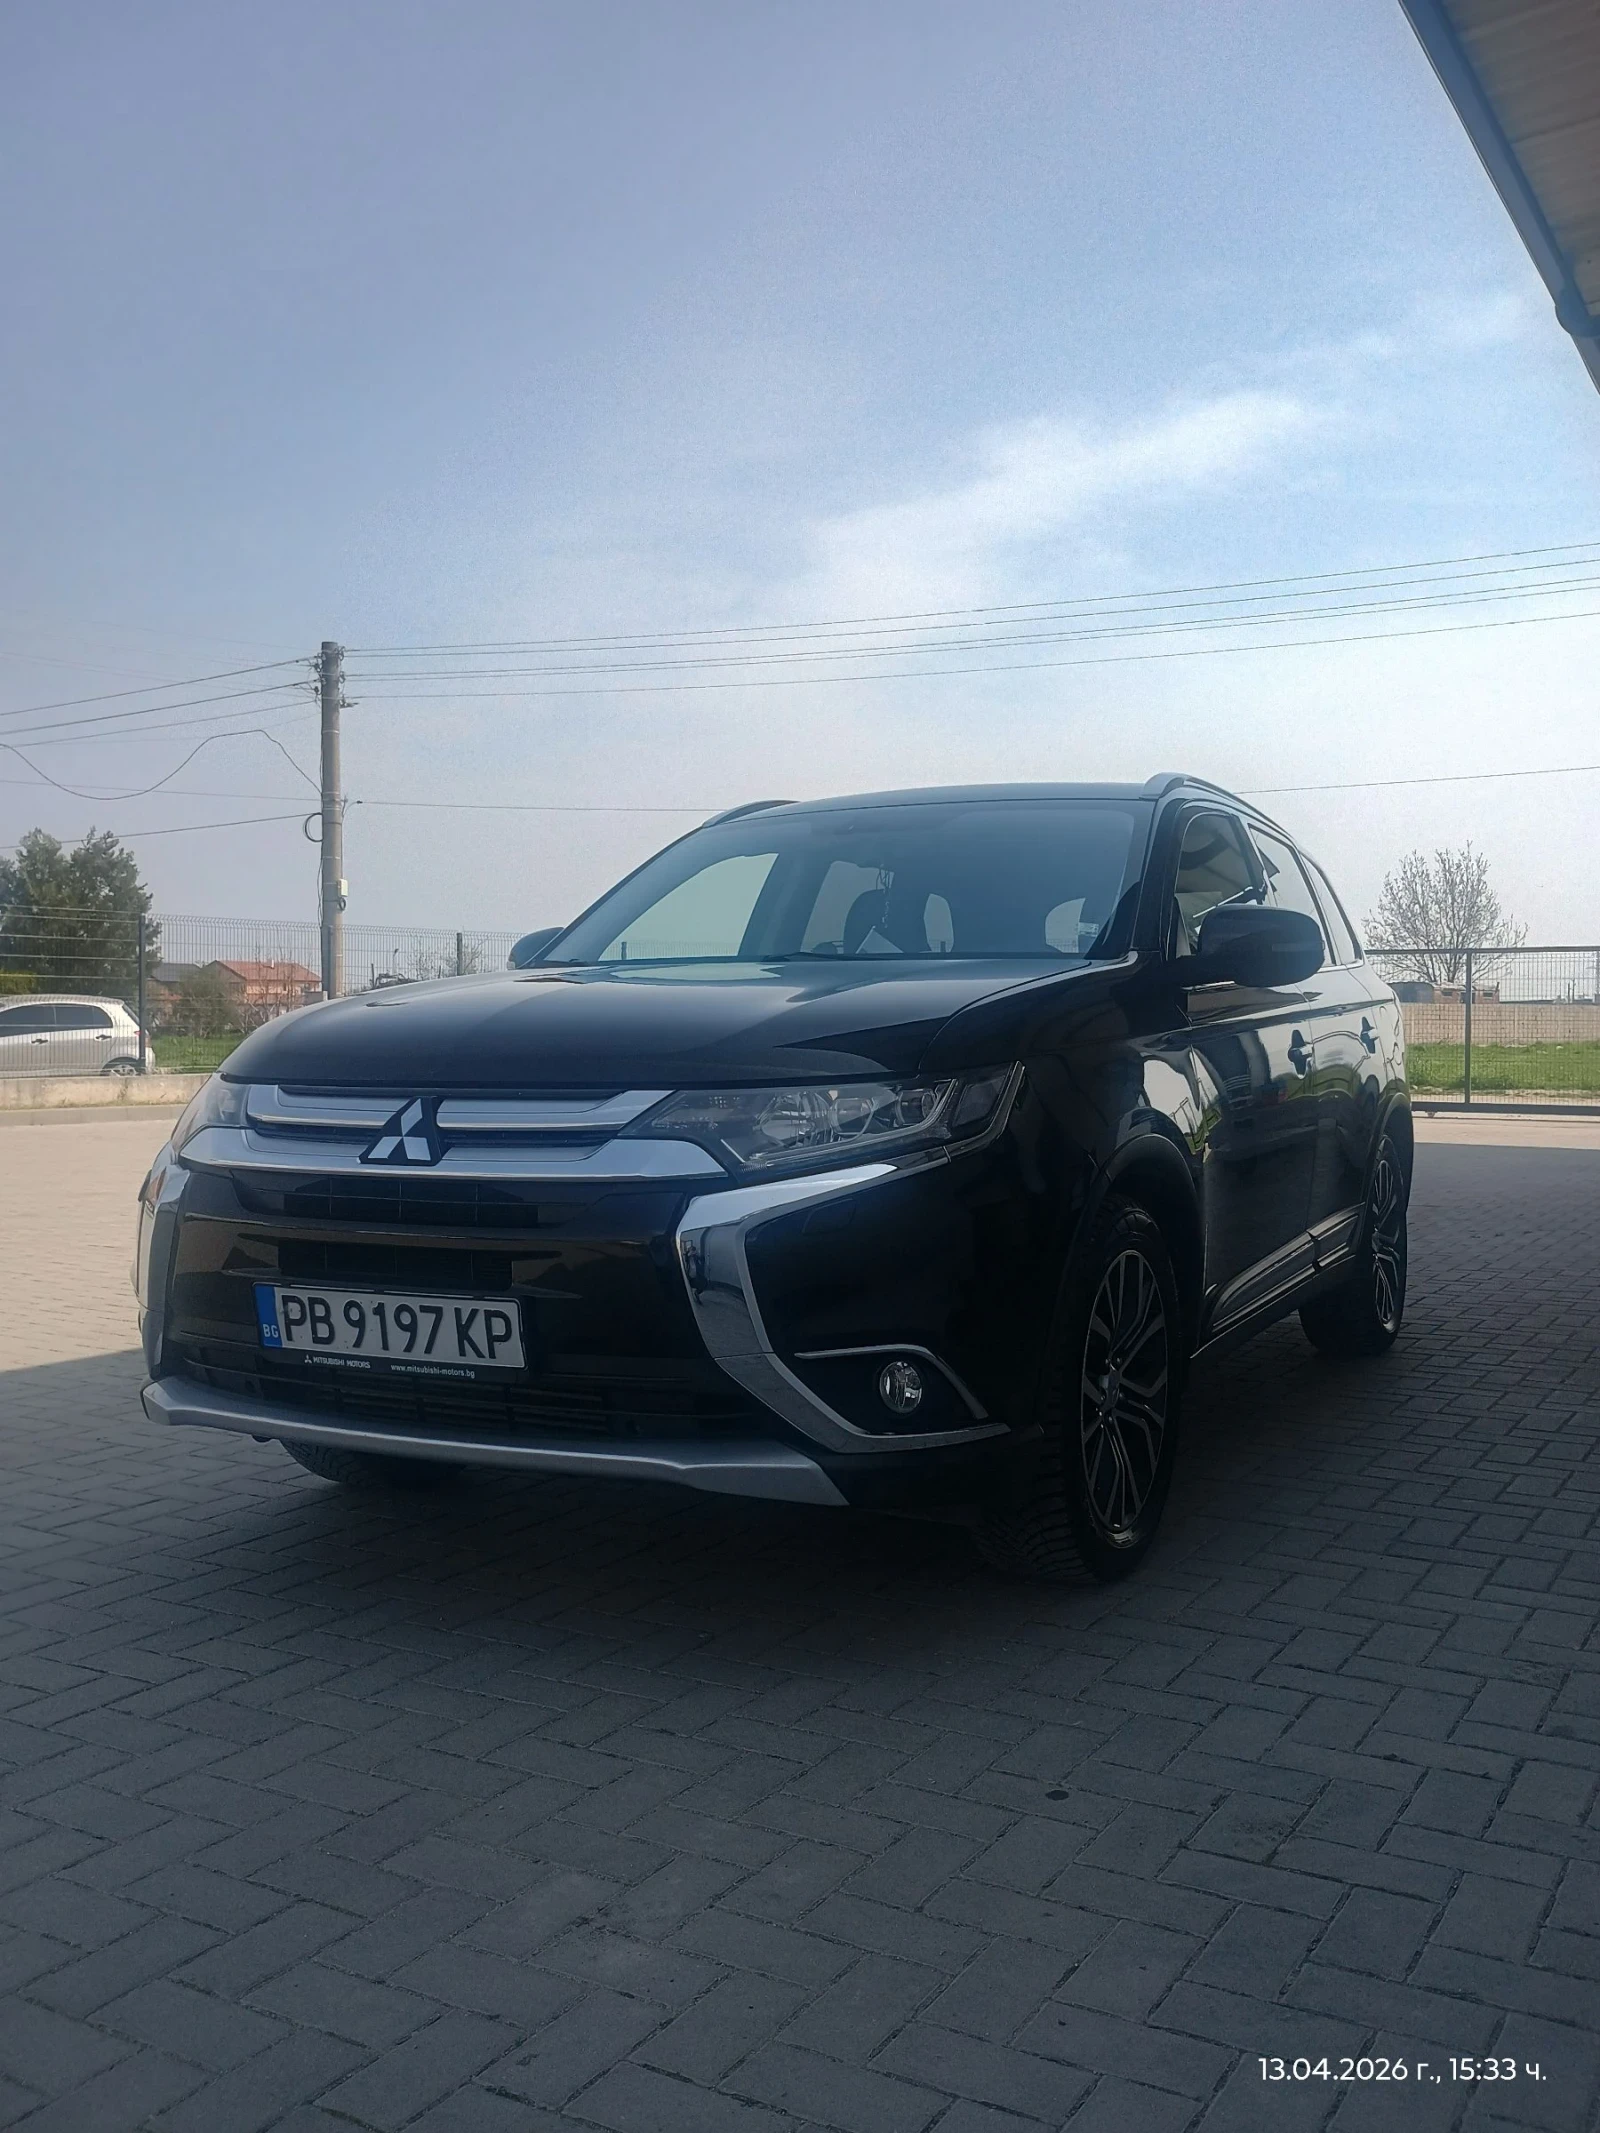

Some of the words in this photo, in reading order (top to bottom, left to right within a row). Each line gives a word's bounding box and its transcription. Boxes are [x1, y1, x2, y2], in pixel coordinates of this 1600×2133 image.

[262, 1323, 279, 1338] BG
[281, 1294, 335, 1345] PB
[343, 1300, 443, 1354] 9197
[454, 1307, 512, 1359] KP
[313, 1356, 345, 1366] MITSUBISHI
[347, 1359, 371, 1368] MOTORS
[390, 1364, 475, 1378] www.mitsubishi-motors.bg
